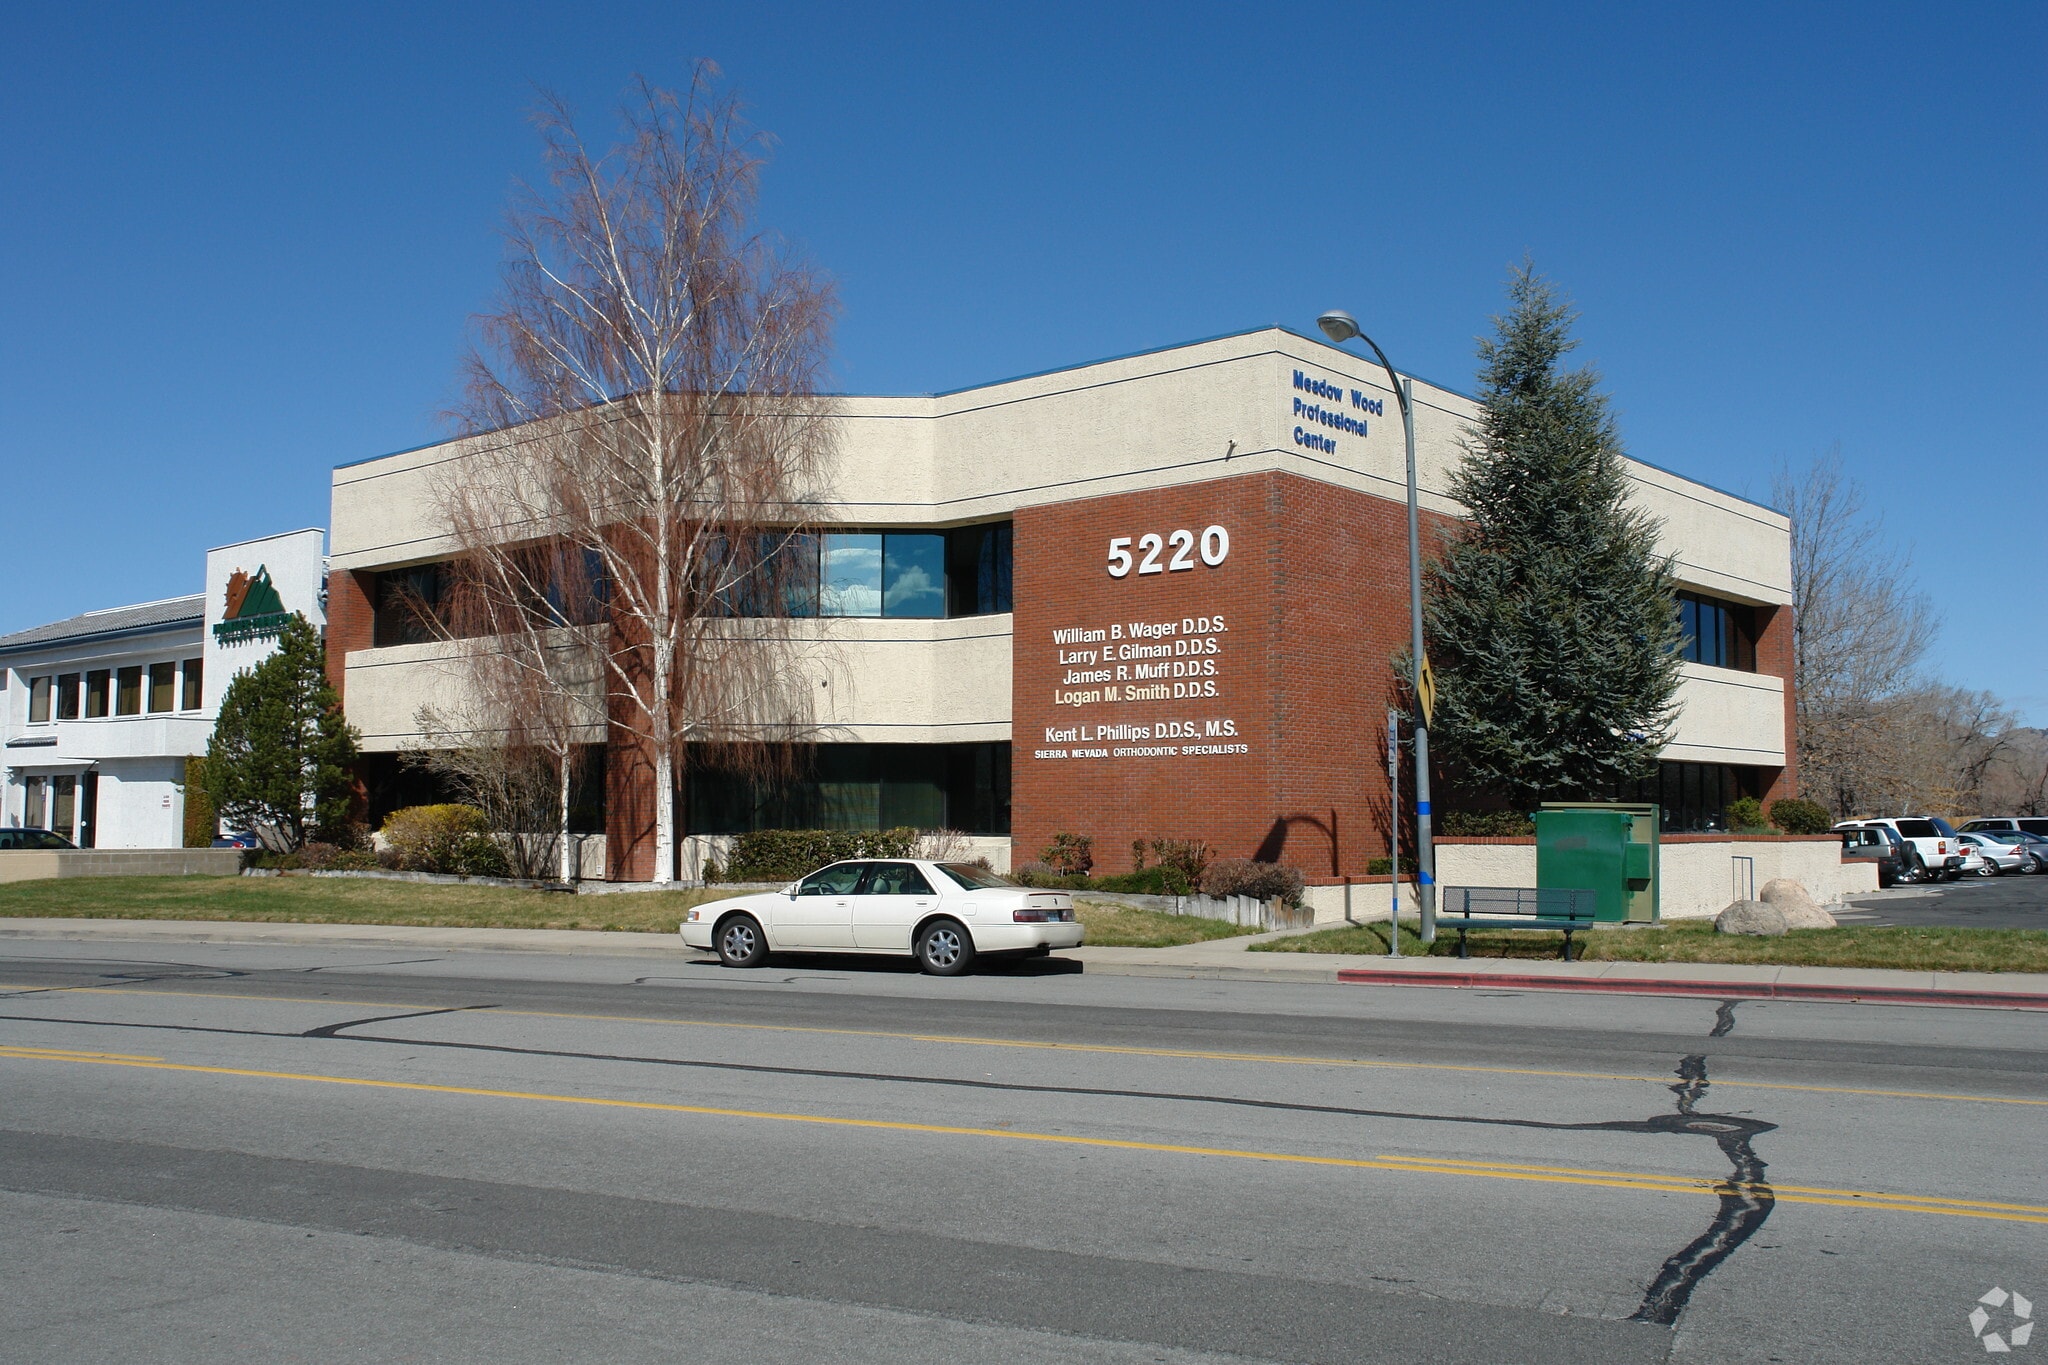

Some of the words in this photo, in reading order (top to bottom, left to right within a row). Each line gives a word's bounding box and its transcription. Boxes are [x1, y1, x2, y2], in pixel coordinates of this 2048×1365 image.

[1293, 369, 1343, 402] Meadow
[1351, 389, 1383, 417] Wood
[1293, 397, 1368, 438] Professional
[1293, 426, 1336, 455] Center
[1107, 525, 1230, 577] 5220
[1053, 627, 1106, 645] William
[1111, 624, 1126, 640] B.
[1129, 622, 1178, 640] Wager
[1182, 615, 1229, 635] D.D.S.
[1059, 649, 1098, 665] Larry
[1103, 646, 1117, 662] E.
[1119, 643, 1172, 661] Gilman
[1175, 637, 1222, 657] D.D.S.
[1063, 669, 1111, 685] James
[1116, 665, 1132, 681] R.
[1135, 662, 1170, 680] Muff
[1173, 659, 1220, 678] D.D.S.
[1055, 689, 1100, 707] Logan
[1104, 686, 1122, 702] M.
[1125, 684, 1170, 701] Smith
[1174, 680, 1220, 700] D.D.S.
[1045, 727, 1078, 743] Kent
[1081, 726, 1094, 742] L.
[1097, 724, 1151, 743] Phillips
[1205, 719, 1239, 738] M.S.
[1034, 750, 1068, 759] SIERRA
[1071, 749, 1108, 758] NEVADA
[1113, 747, 1178, 757] ORTHODONTIC
[1181, 744, 1248, 755] SPECIALISTS
